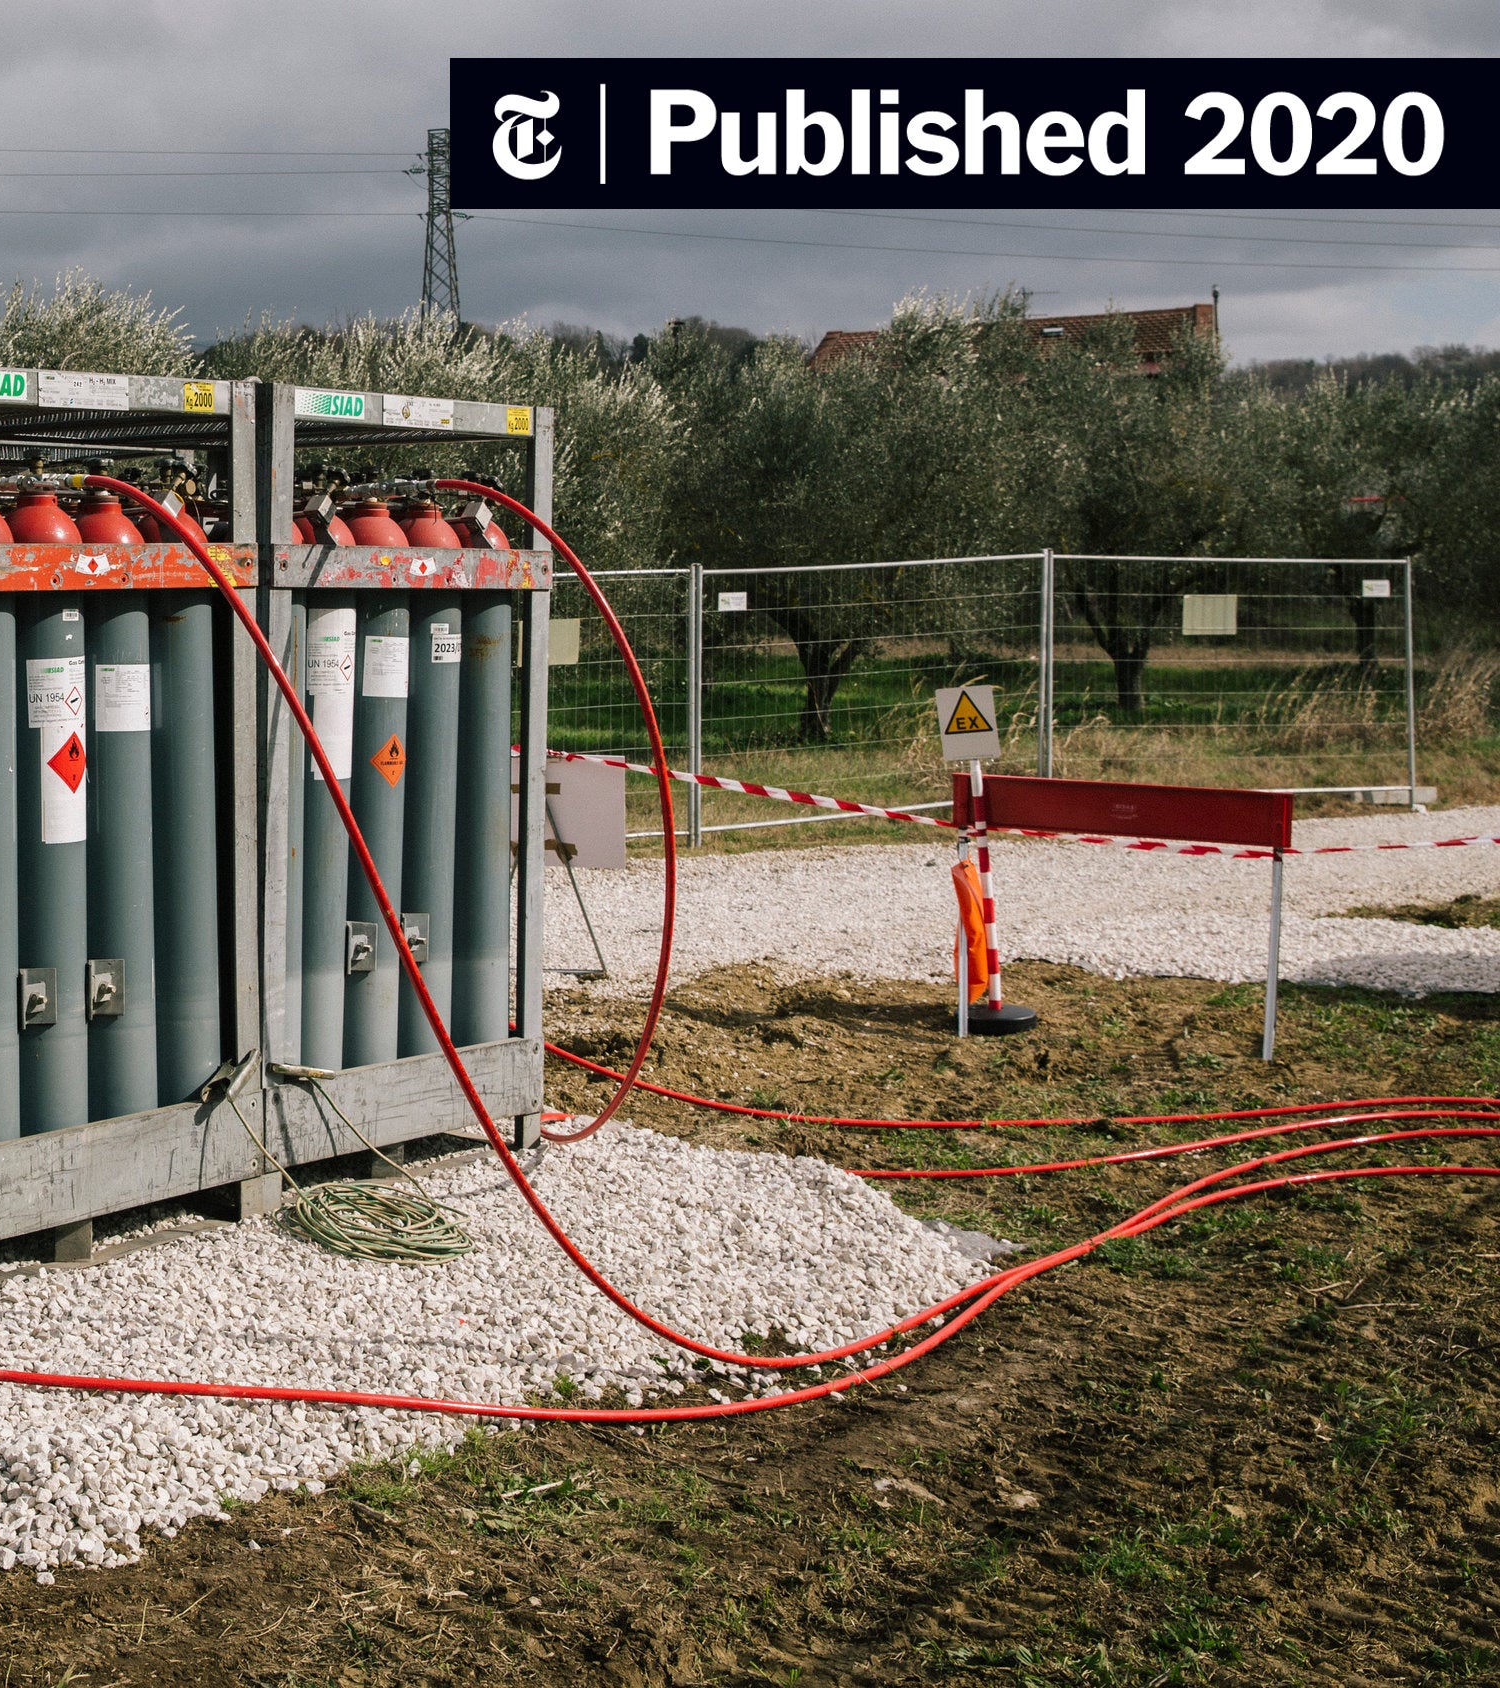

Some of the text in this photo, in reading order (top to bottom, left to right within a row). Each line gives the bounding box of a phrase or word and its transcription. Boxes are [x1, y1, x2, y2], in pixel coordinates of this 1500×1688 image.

[194, 392, 213, 408] 2000
[332, 395, 364, 417] SIAD
[514, 417, 529, 431] 2000
[307, 659, 320, 669] UN
[28, 692, 65, 704] UN 1954
[956, 716, 980, 730] EX
